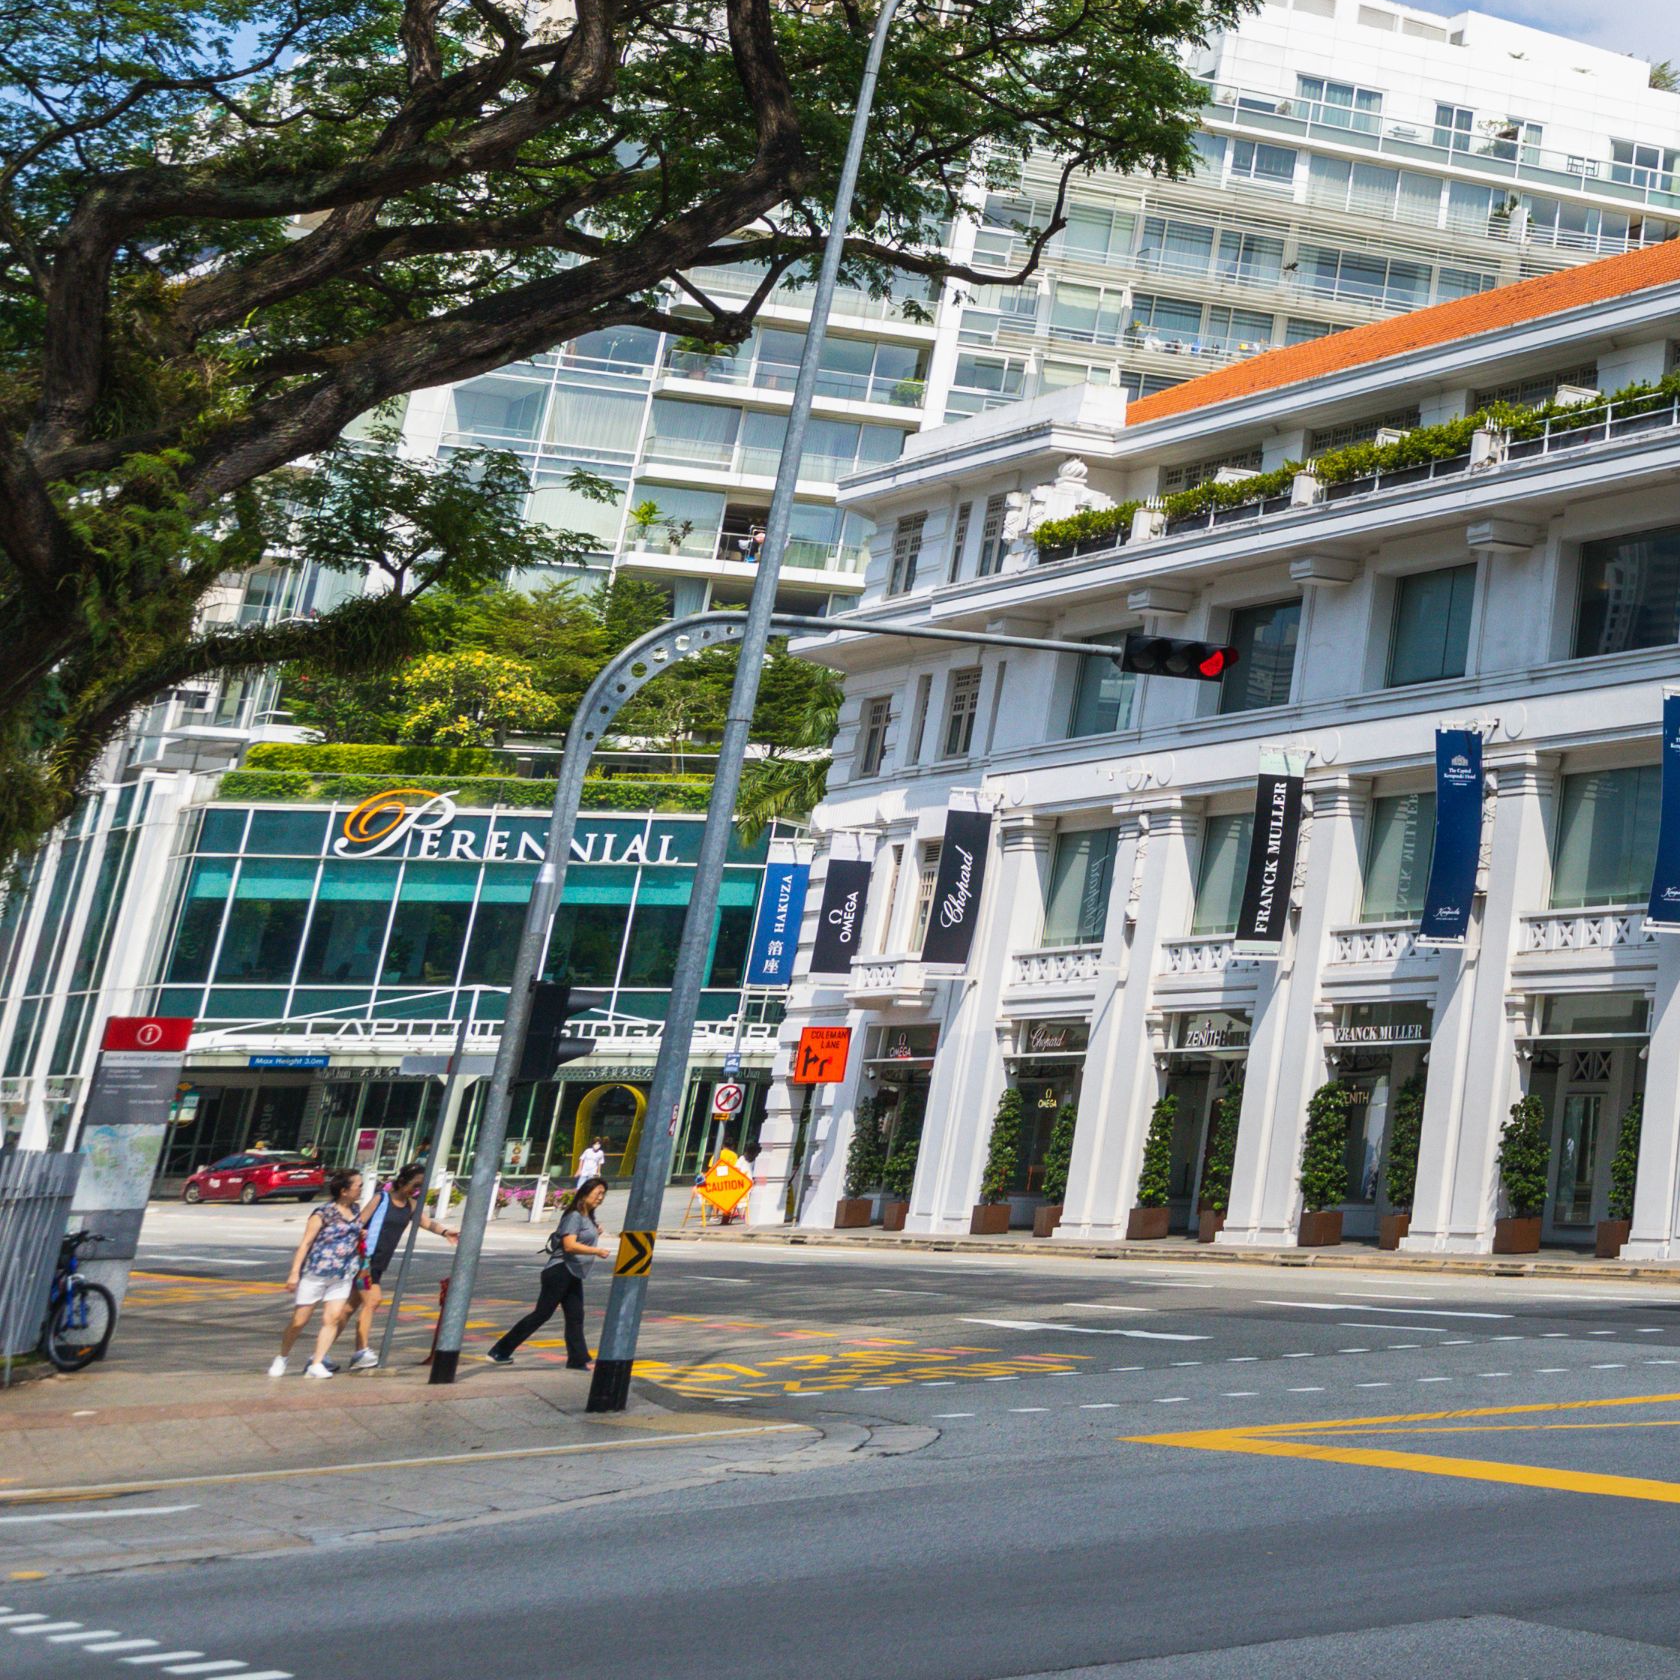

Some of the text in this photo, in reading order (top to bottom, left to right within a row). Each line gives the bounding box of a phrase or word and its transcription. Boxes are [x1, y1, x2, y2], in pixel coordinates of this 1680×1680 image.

[333, 788, 679, 866] PERENNIAL
[1254, 781, 1288, 934] FRANCK MULLER
[940, 844, 974, 928] Chopard
[773, 874, 793, 934] HAKUZA
[839, 891, 859, 944] OMEGA
[811, 1030, 848, 1040] COLEMAN
[1030, 1027, 1068, 1050] Chopard
[1185, 1029, 1221, 1047] ZENITH
[1335, 1024, 1423, 1041] FRANCK MULLER
[820, 1040, 840, 1050] LANE
[889, 1046, 912, 1057] OMEGA
[254, 1056, 324, 1067] Max Height 3.0m
[1038, 1098, 1057, 1108] OMEGA
[1344, 1090, 1370, 1105] ENITH
[705, 1179, 745, 1193] CAUTION
